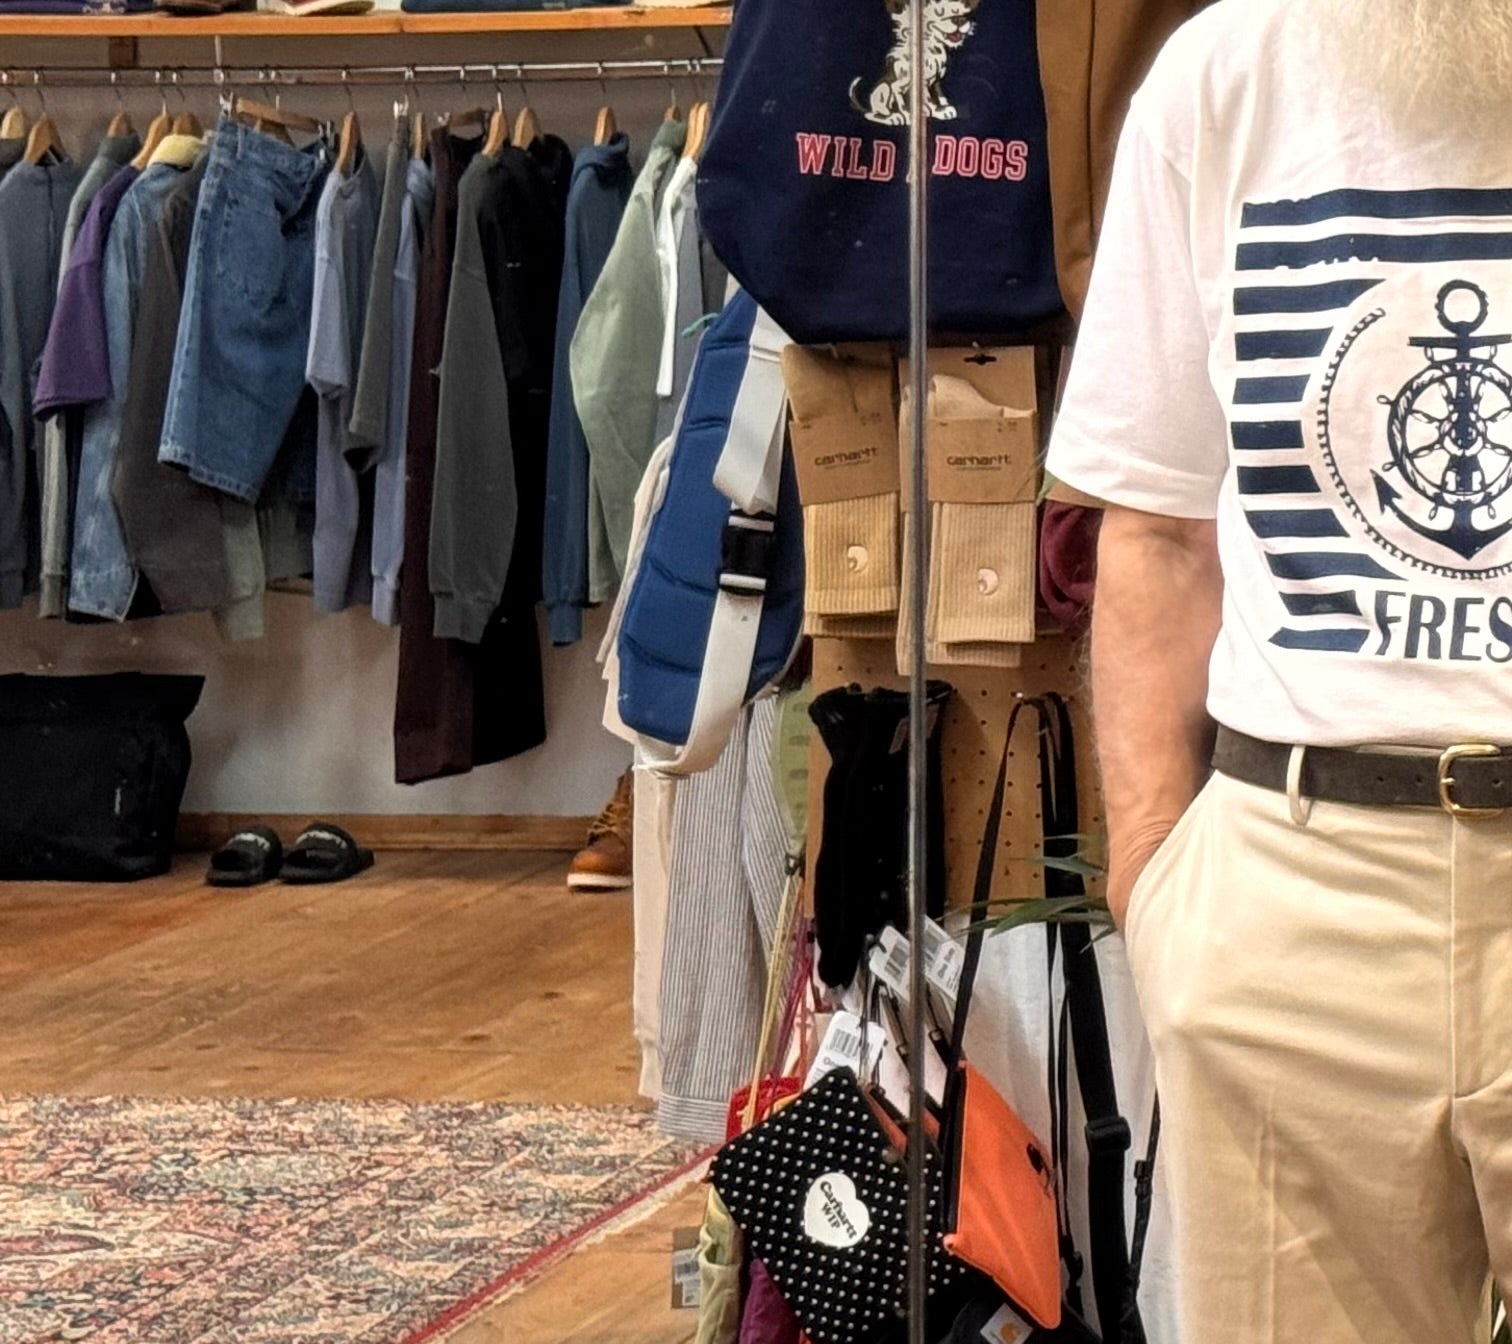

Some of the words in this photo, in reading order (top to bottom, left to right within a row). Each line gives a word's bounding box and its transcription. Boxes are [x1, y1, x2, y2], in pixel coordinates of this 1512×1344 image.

[796, 132, 897, 183] WILD
[931, 134, 1029, 182] DOGS
[814, 446, 878, 466] carhartt
[821, 1201, 841, 1229] WIP
